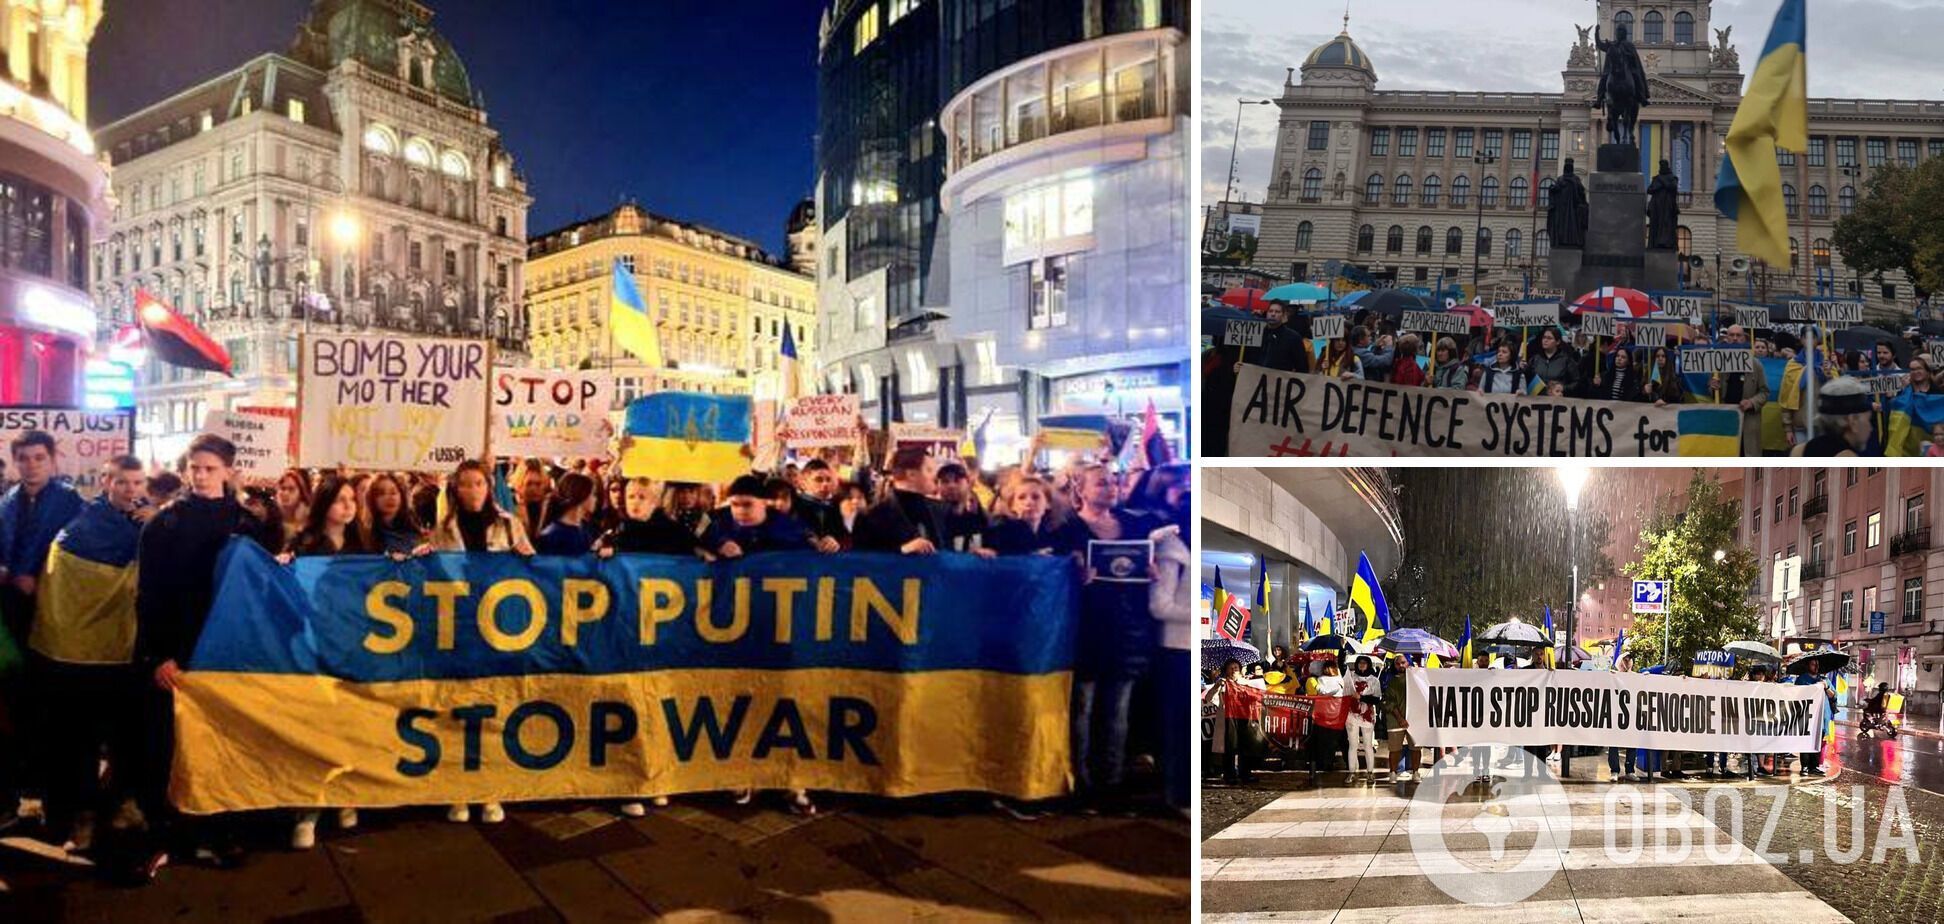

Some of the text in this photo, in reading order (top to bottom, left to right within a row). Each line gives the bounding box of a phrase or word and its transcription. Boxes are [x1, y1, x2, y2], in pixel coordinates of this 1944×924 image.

[1666, 299, 1698, 318] ODESA
[1737, 309, 1769, 329] DNIPRO
[1790, 302, 1859, 321] KROYVNYTSKYI
[1315, 319, 1342, 337] LVIV
[1402, 312, 1466, 334] ZAPORIZHZHIA
[1583, 315, 1617, 336] RIVNE
[1231, 335, 1254, 345] RIH
[1637, 326, 1664, 345] KYIV
[314, 339, 483, 381] BOMB YOUR
[1683, 351, 1753, 372] ZHYTOMYR
[338, 379, 451, 408] MOTHER
[496, 374, 597, 411] STOP
[798, 396, 845, 407] EVERY
[791, 405, 852, 416] RUSSIAN
[815, 417, 827, 425] IS
[1242, 374, 1677, 457] AIR DEFENCE SYSTEMS for
[329, 406, 443, 437] NOT MY
[506, 414, 582, 439] WAR
[76, 438, 125, 457] OFF
[347, 431, 437, 466] CITY
[1636, 583, 1647, 599] P
[363, 577, 922, 654] STOP PUTIN
[1696, 650, 1730, 663] VICTORY
[1428, 686, 1485, 729] NATO
[1490, 687, 1540, 729] STOP
[1635, 690, 1716, 735] GENOCIDE
[1720, 696, 1740, 735] IN
[1743, 698, 1813, 737] UKRAINE
[395, 696, 881, 778] STOP WAR
